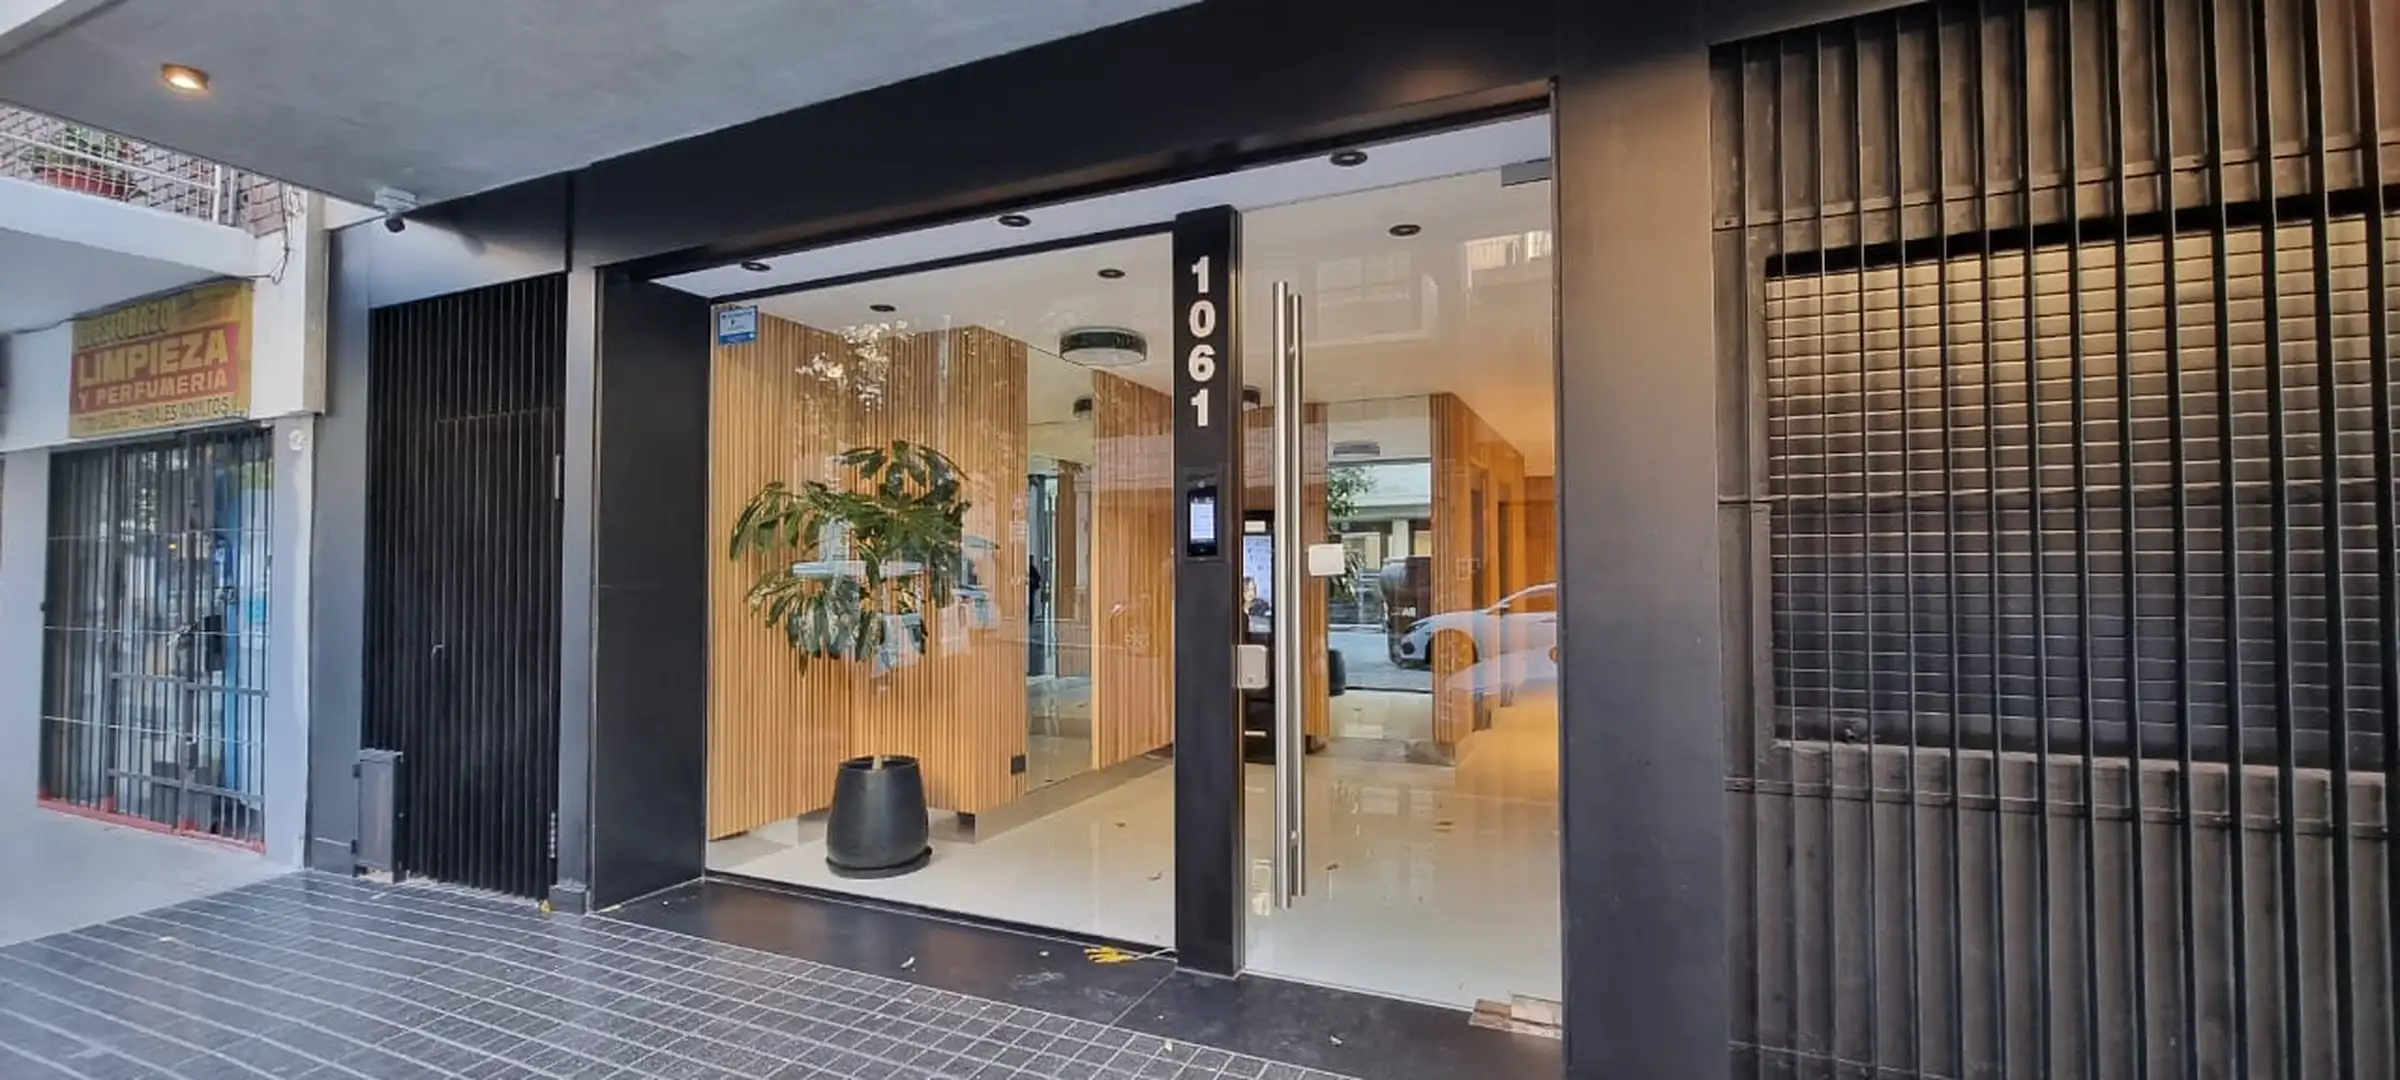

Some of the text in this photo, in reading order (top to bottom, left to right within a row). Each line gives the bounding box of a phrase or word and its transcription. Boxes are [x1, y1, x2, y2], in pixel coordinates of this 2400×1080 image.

[77, 329, 229, 388] LIMPIEZA
[1188, 255, 1215, 427] 1061
[78, 369, 228, 409] Y PERFUMERIA
